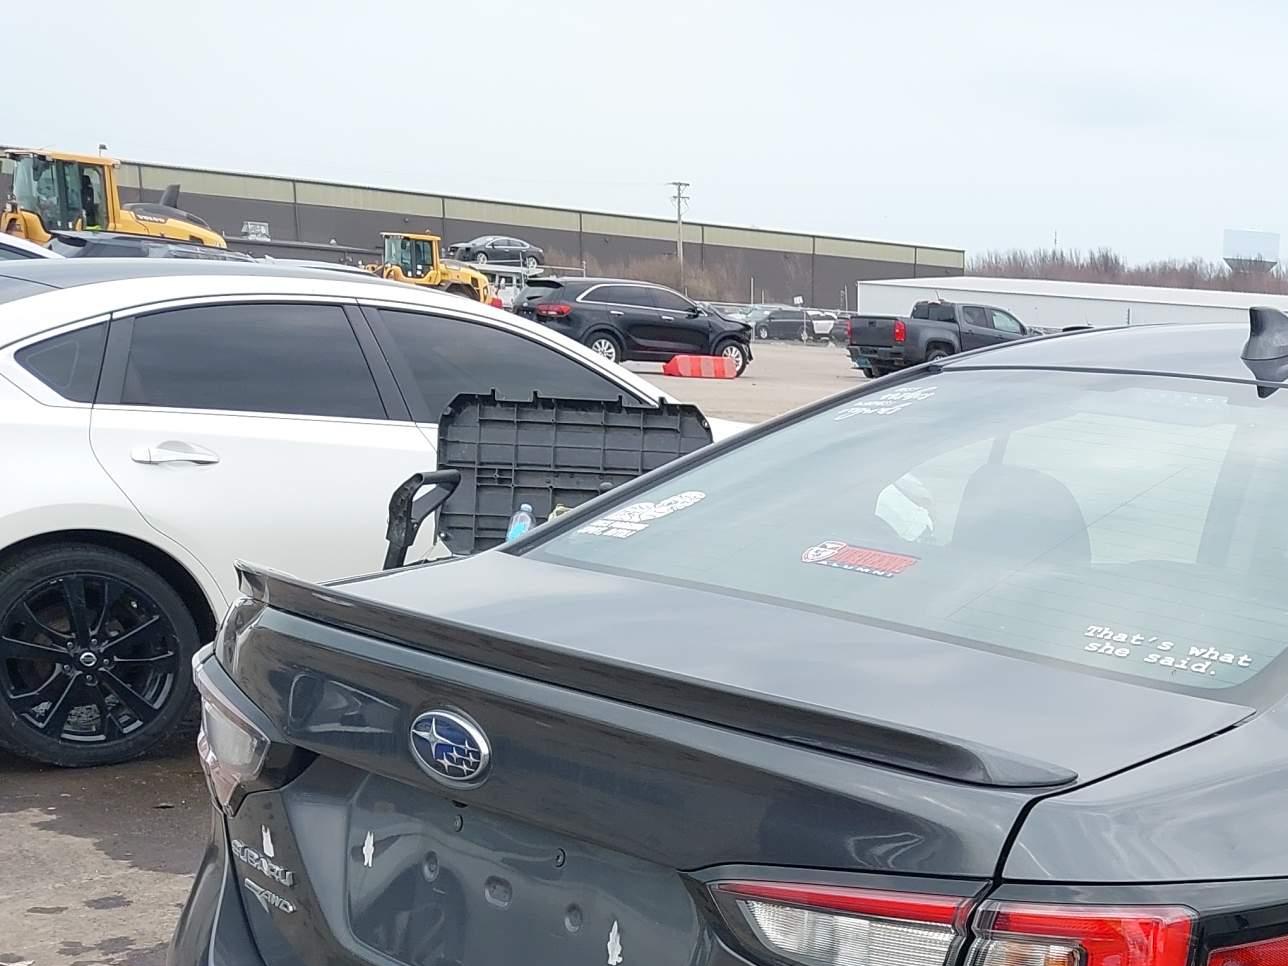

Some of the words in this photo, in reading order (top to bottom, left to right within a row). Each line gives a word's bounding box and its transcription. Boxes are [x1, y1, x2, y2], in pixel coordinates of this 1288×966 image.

[816, 559, 895, 578] ALUMNI
[1084, 624, 1175, 652] That's
[1188, 645, 1253, 667] what
[1084, 641, 1131, 658] she
[1143, 652, 1217, 676] said.
[231, 839, 294, 888] SUBARU
